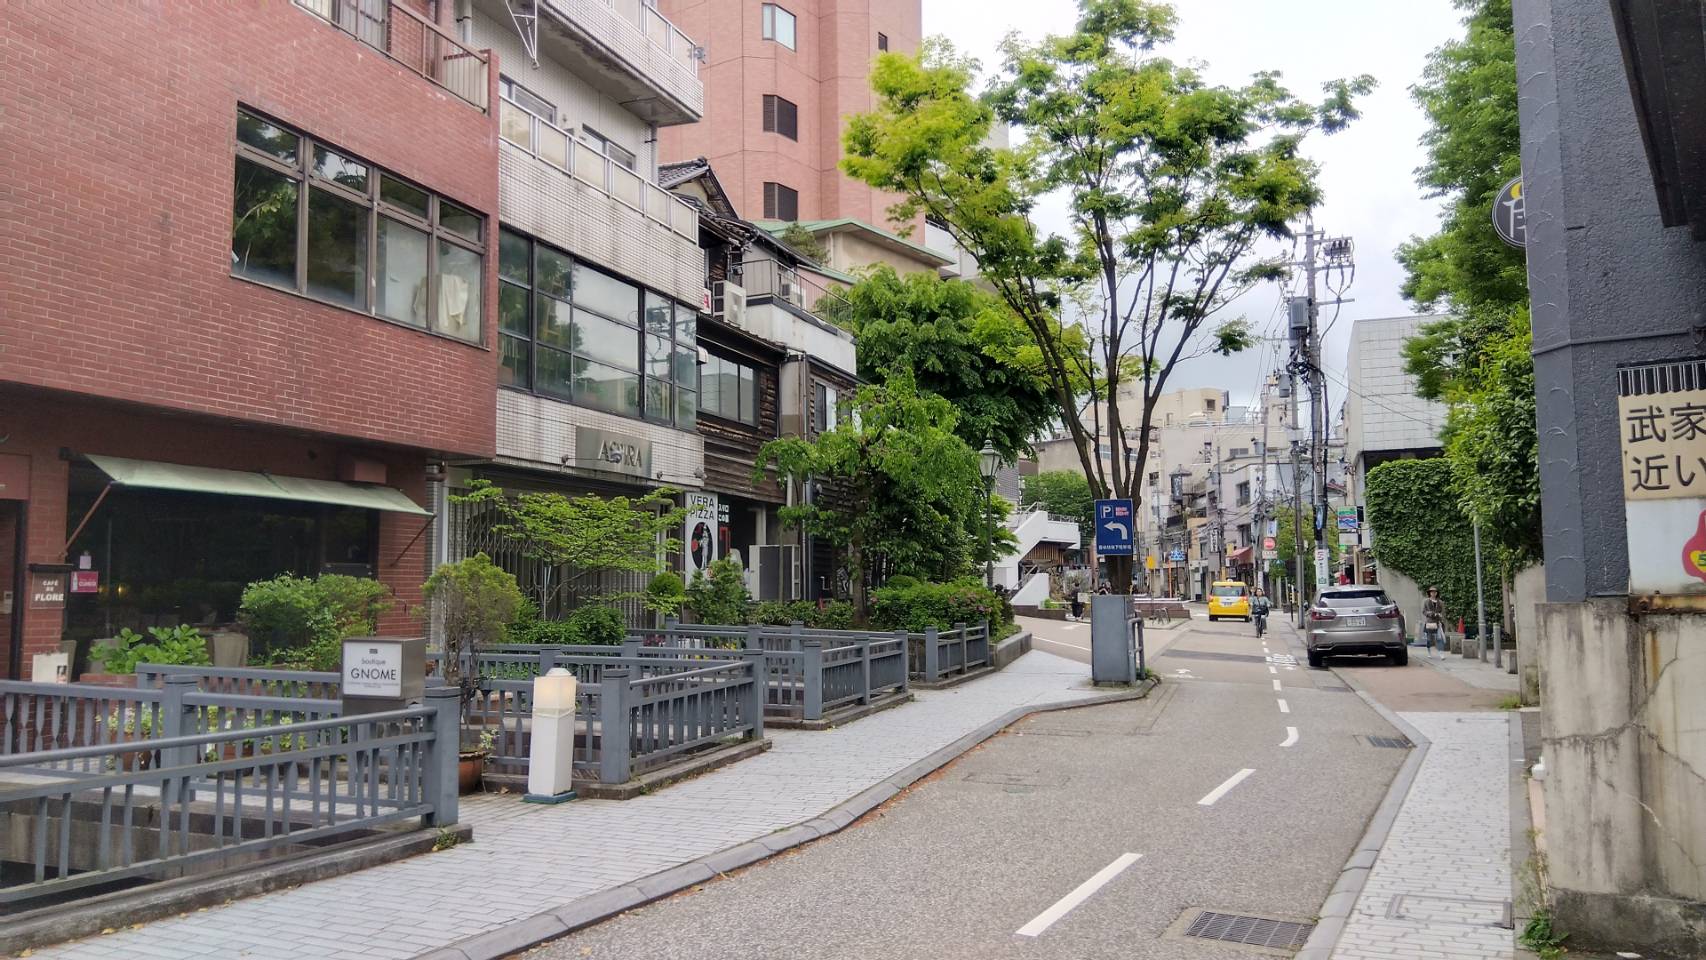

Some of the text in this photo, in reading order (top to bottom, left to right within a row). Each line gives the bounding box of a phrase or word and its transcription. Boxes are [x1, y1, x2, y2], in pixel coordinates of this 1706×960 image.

[1626, 402, 1706, 443] 武家
[1630, 454, 1706, 492] 近い
[690, 495, 715, 508] VERA
[690, 508, 715, 520] PIZZA
[1102, 505, 1112, 519] P
[34, 593, 65, 602] FLORE
[350, 667, 397, 680] GNOME
